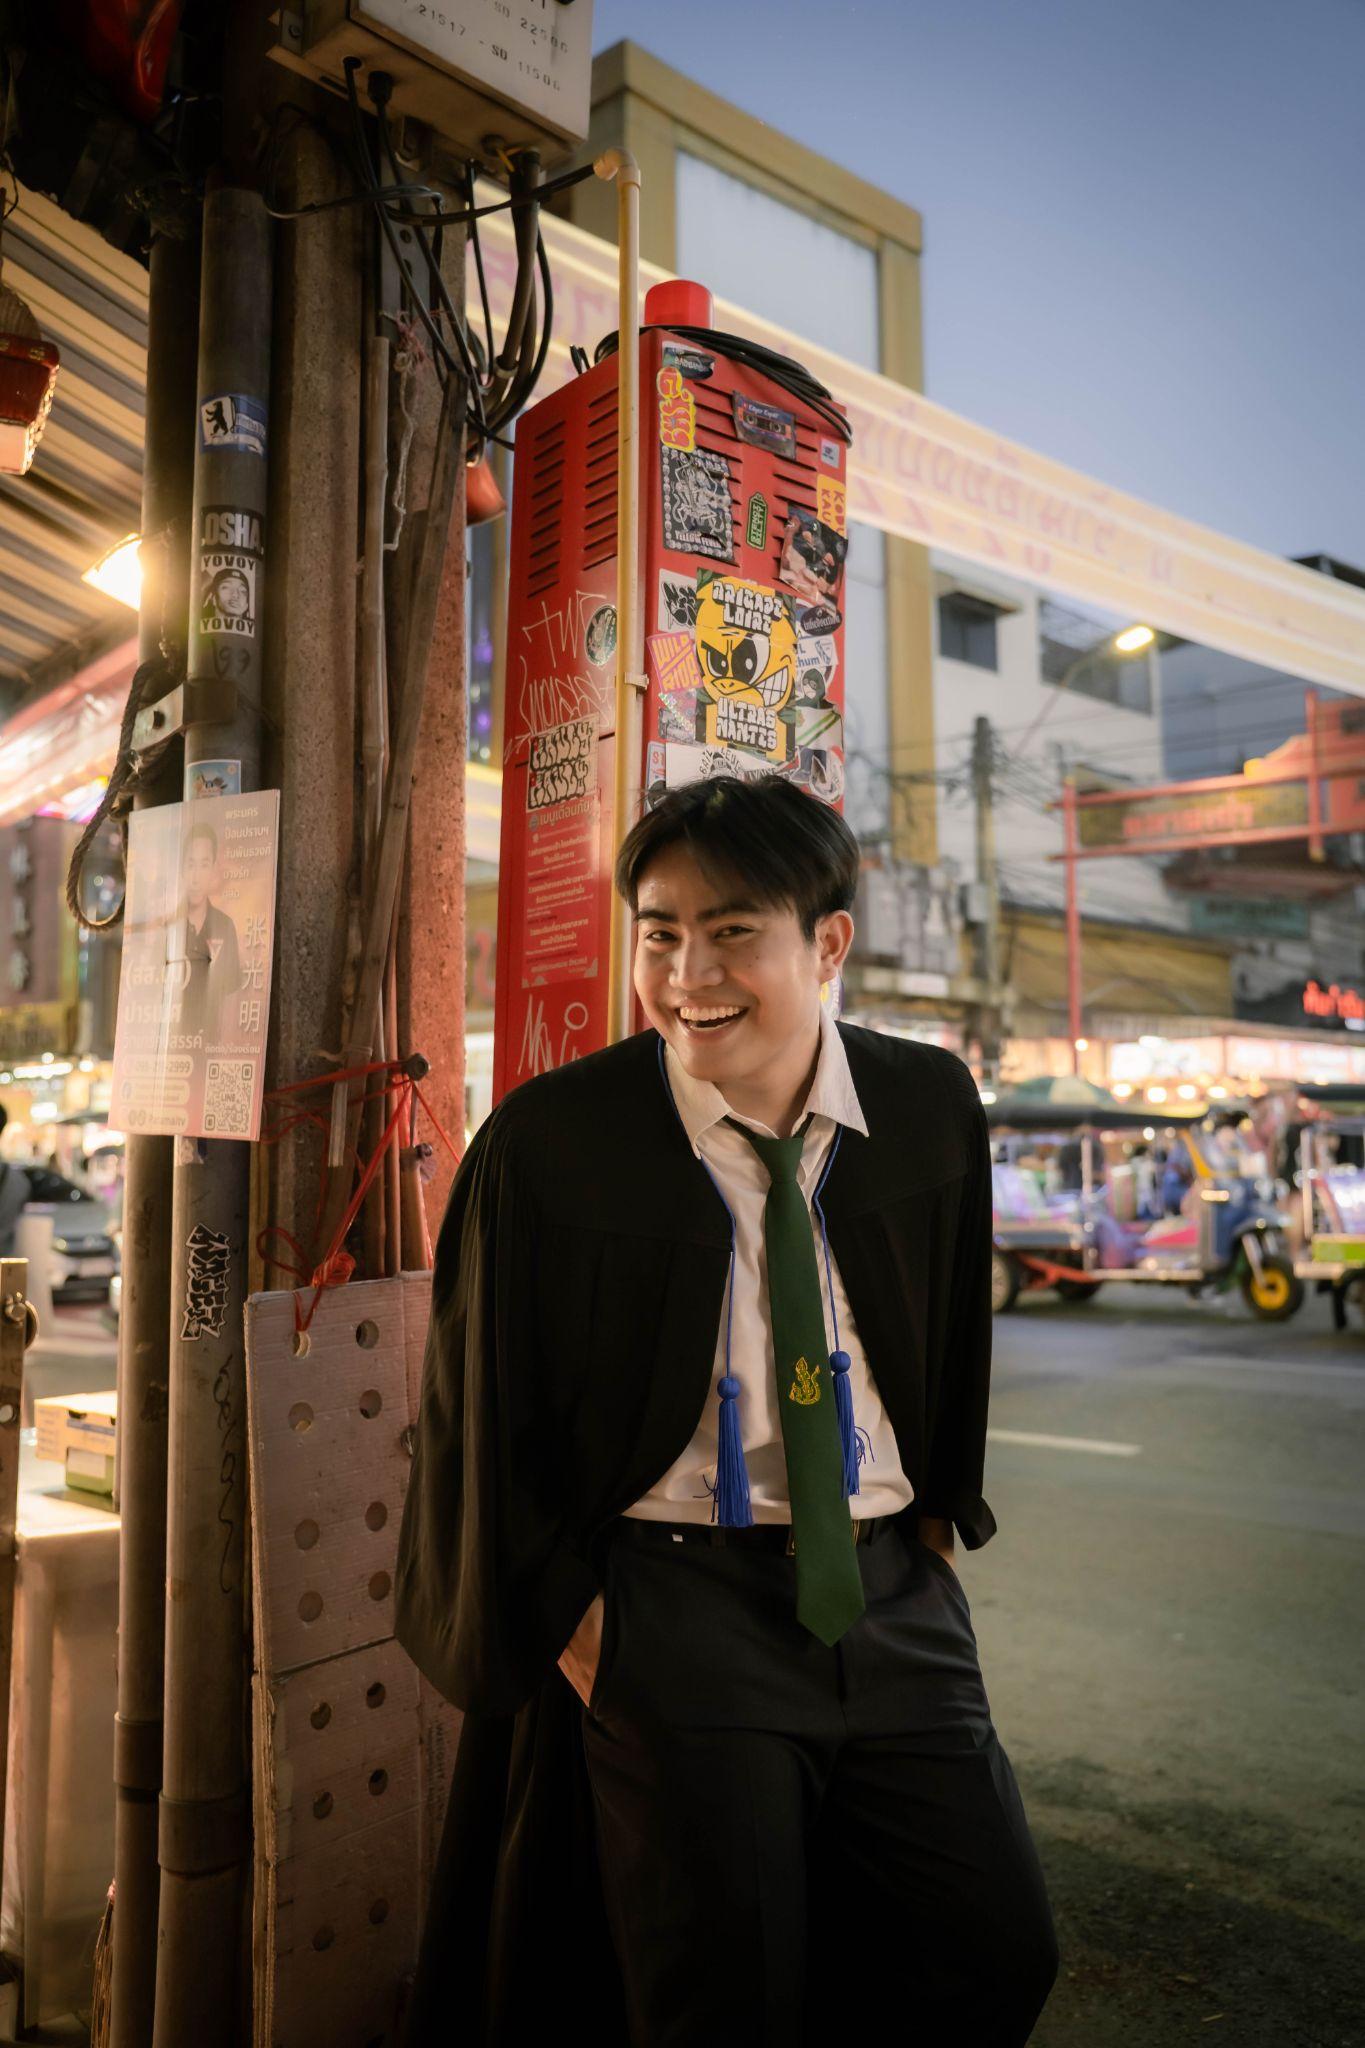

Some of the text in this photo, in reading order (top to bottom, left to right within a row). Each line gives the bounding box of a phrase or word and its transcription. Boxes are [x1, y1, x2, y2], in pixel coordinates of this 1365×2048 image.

[203, 555, 255, 571] YOVOY
[202, 618, 254, 635] YOVOY
[717, 697, 776, 728] ULTRAS
[716, 717, 777, 750] NANTES
